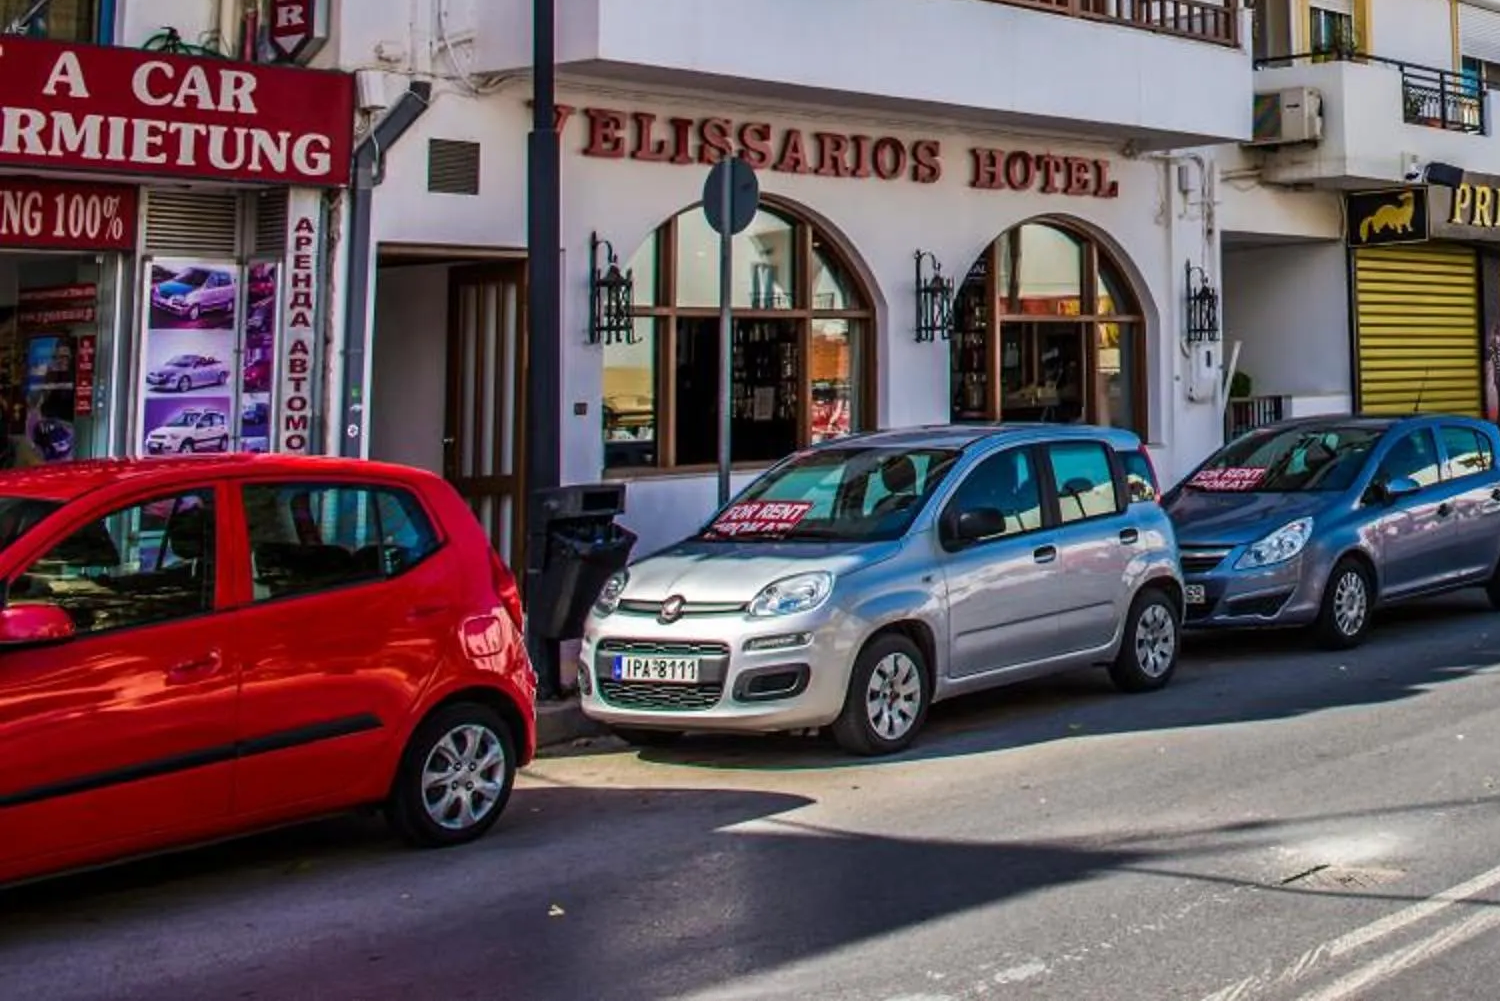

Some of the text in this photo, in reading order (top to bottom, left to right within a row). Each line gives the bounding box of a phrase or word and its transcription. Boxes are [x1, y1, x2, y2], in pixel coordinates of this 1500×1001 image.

[42, 51, 258, 114] A CAR
[0, 106, 332, 176] RMIETUNG
[969, 148, 1119, 199] HOTEL
[52, 193, 123, 240] 100%
[290, 216, 314, 328] АРЕНДА
[719, 502, 811, 521] FOR RENT
